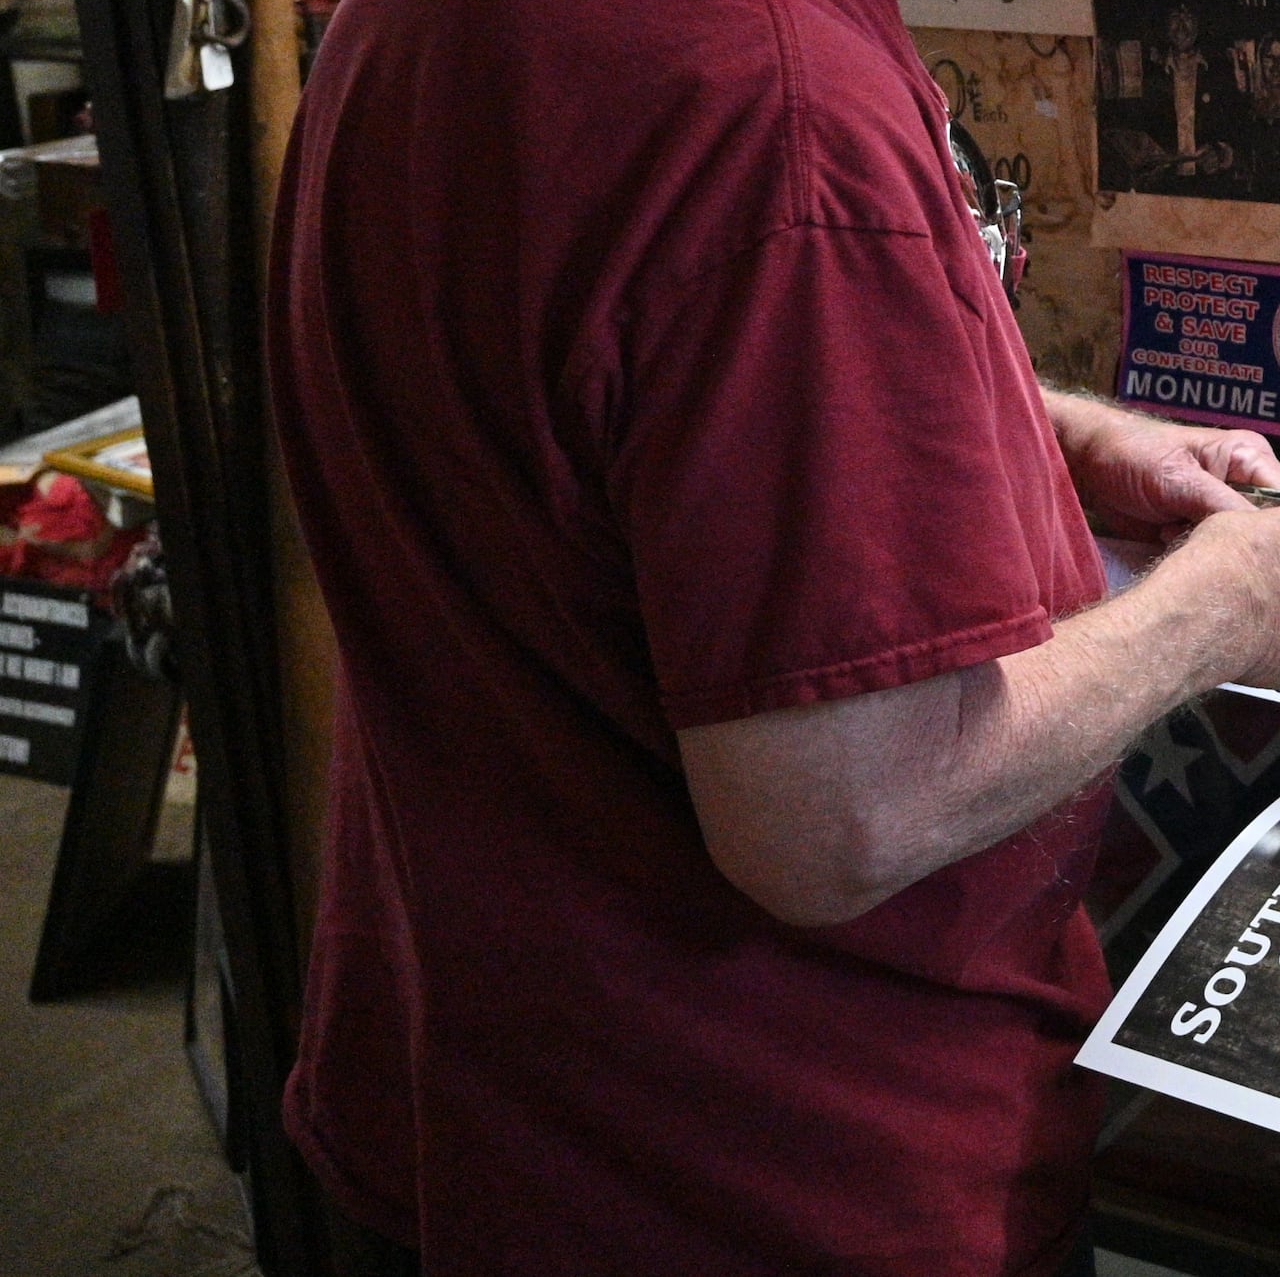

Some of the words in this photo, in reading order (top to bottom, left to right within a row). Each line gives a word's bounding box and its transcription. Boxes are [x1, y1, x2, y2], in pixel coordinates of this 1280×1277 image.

[1143, 263, 1258, 296] RESPECT
[1144, 286, 1260, 321] PROTECT
[1155, 312, 1174, 334] &
[1180, 316, 1247, 343] SAVE
[1179, 339, 1219, 359] OUR
[1131, 348, 1264, 384] CONFEDERATE
